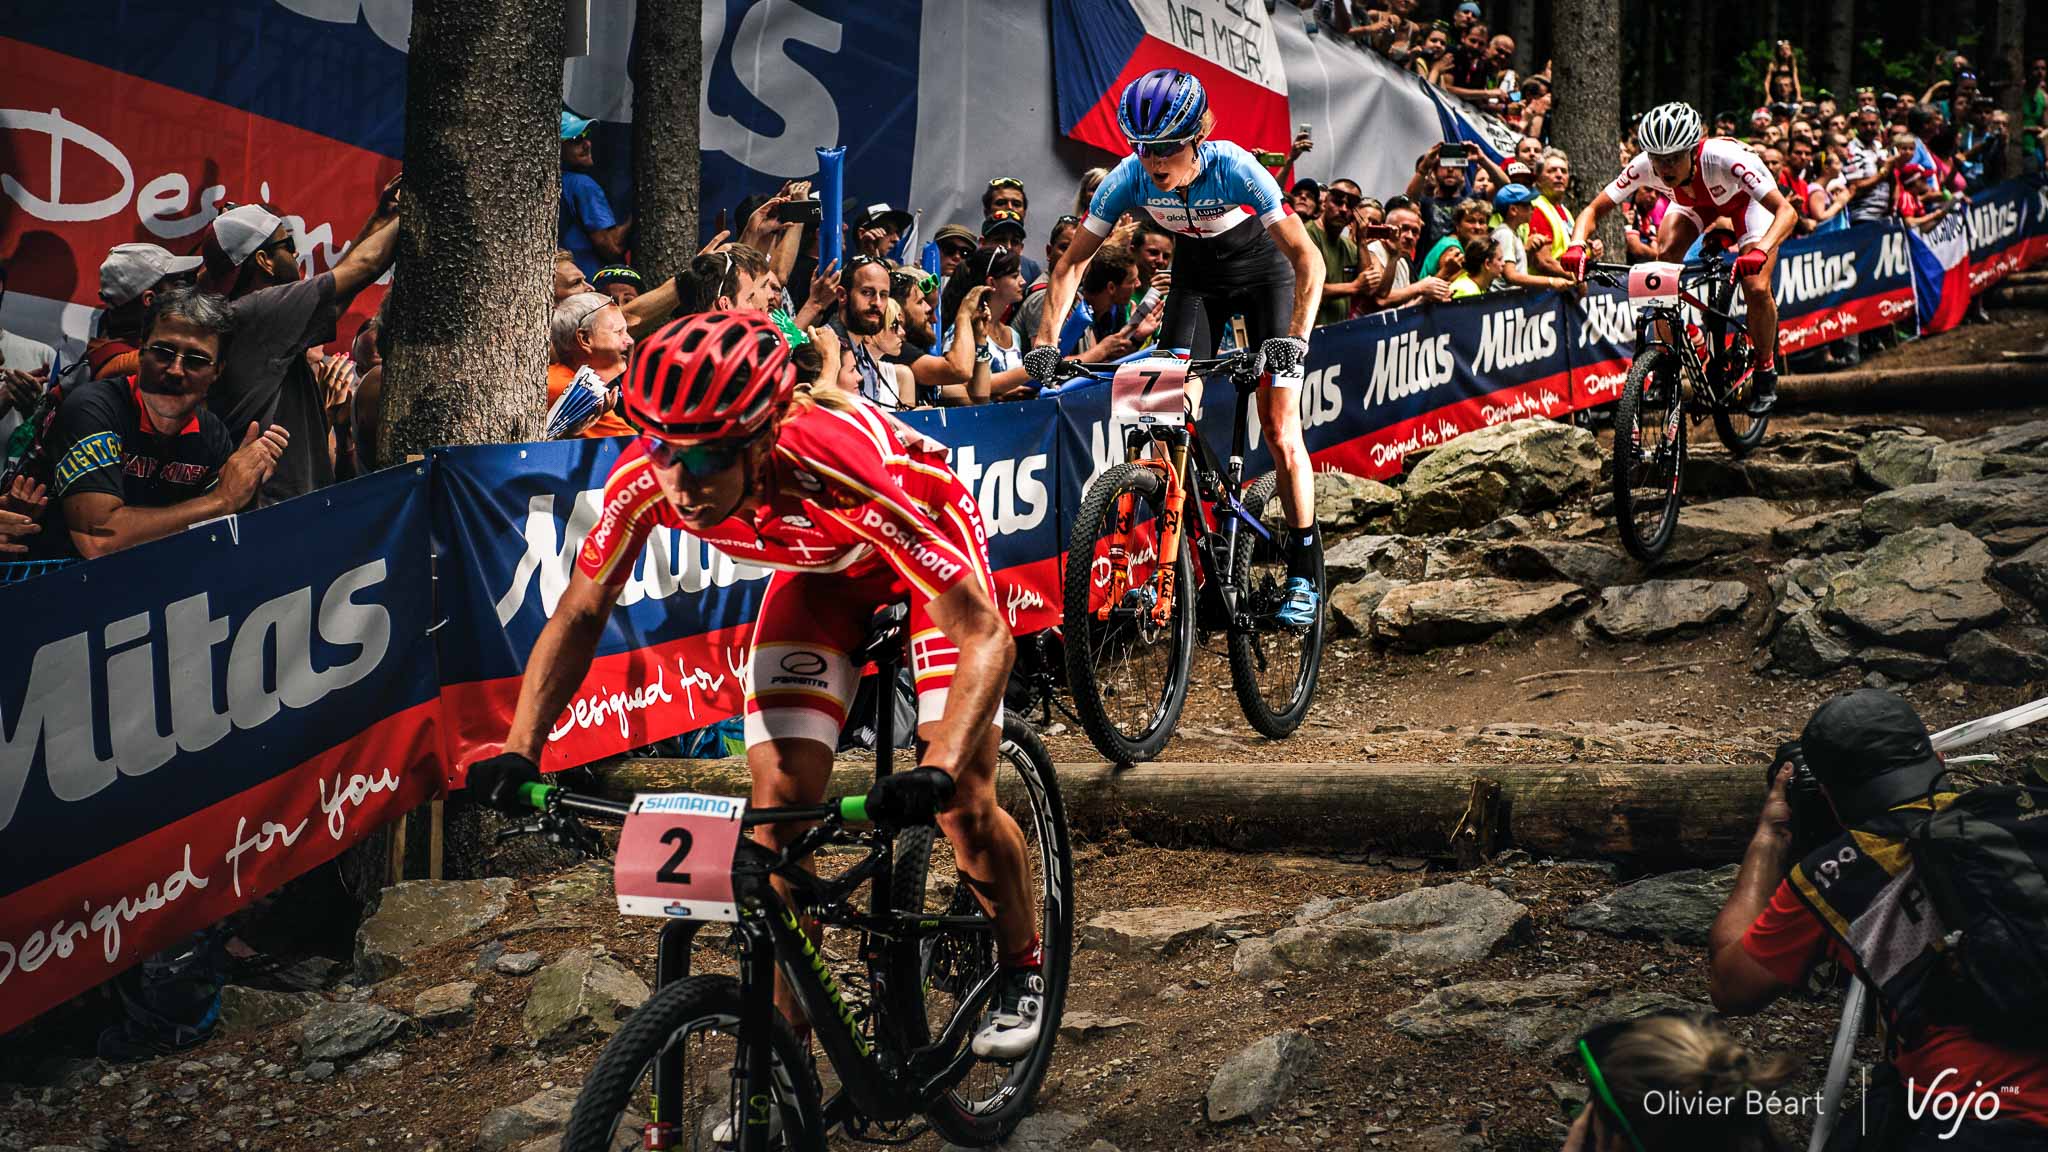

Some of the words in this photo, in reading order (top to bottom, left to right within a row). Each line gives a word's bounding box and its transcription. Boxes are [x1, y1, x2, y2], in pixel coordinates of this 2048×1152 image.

[1198, 208, 1223, 216] LUNA
[1645, 272, 1661, 291] 6
[1776, 250, 1857, 307] Mitas
[1364, 330, 1454, 411] Mitas
[1471, 307, 1557, 377] Mitas
[1139, 371, 1161, 401] 7
[1481, 393, 1526, 427] Designed
[1522, 391, 1540, 415] for
[1539, 388, 1560, 415] You
[1370, 427, 1421, 468] Designed
[1422, 423, 1439, 446] for
[1438, 418, 1459, 444] You
[594, 469, 655, 549] postnord
[862, 509, 962, 582] postnord
[0, 557, 391, 832] Mitas
[679, 657, 724, 720] for
[225, 816, 308, 897] for
[319, 768, 400, 841] You
[645, 796, 730, 814] SHIMANO
[656, 826, 693, 885] 2
[1814, 846, 1858, 889] 190
